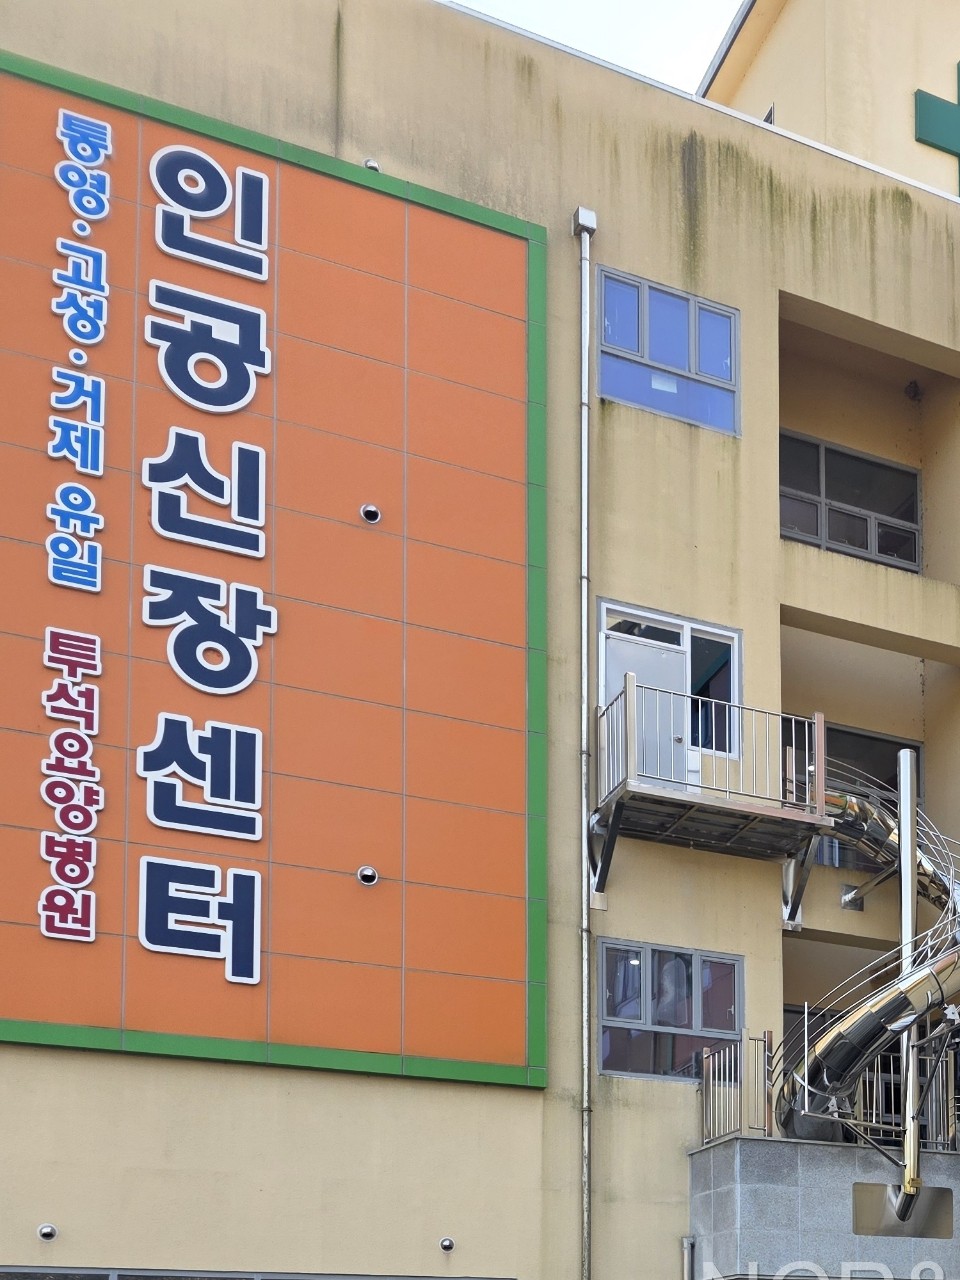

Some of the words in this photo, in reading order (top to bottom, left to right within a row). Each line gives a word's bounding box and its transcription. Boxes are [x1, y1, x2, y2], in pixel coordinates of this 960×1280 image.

[46, 482, 104, 593] 유일
[136, 144, 278, 984] 인공신장센터
[38, 626, 104, 942] 투석요양병원
